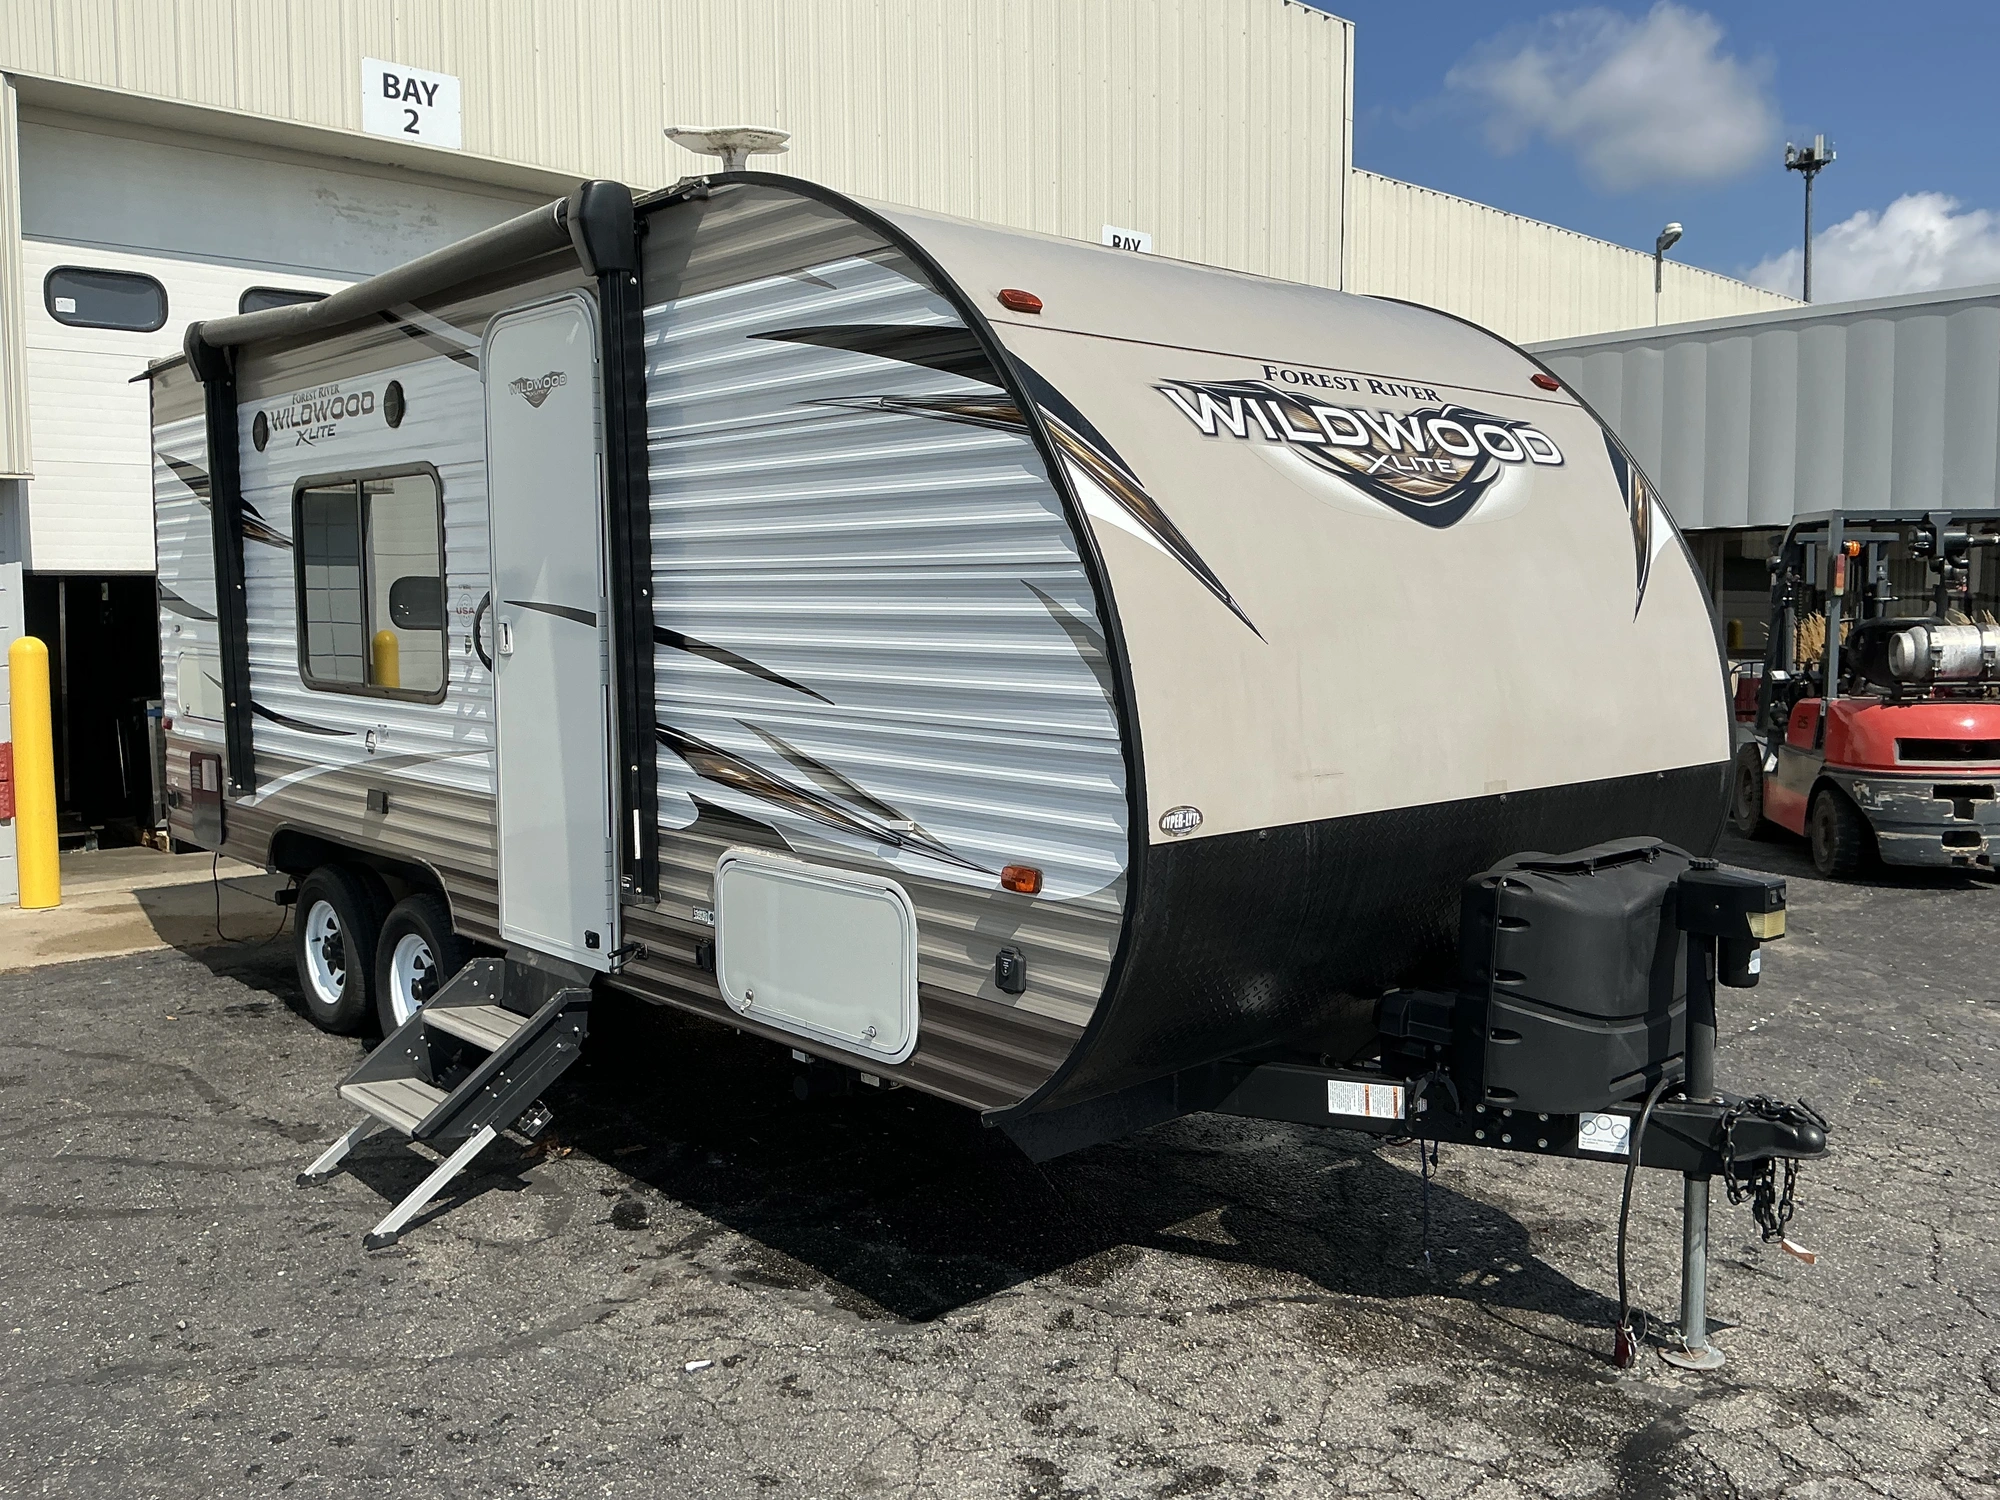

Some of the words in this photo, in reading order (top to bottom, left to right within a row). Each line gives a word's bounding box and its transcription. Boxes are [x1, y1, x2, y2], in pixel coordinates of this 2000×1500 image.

[382, 72, 440, 107] BAY
[403, 108, 420, 135] 2
[1112, 234, 1142, 252] BAY
[292, 389, 317, 405] FOREST
[318, 383, 340, 399] RIVER
[508, 374, 568, 395] WILDWOOD
[1260, 364, 1360, 392] FOREST
[1364, 377, 1444, 402] RIVER
[270, 391, 376, 431] WILDWOOD
[295, 423, 337, 447] XLITE
[1154, 386, 1564, 466] WILDWOOD
[1359, 452, 1458, 476] XLITE
[456, 606, 475, 615] USA
